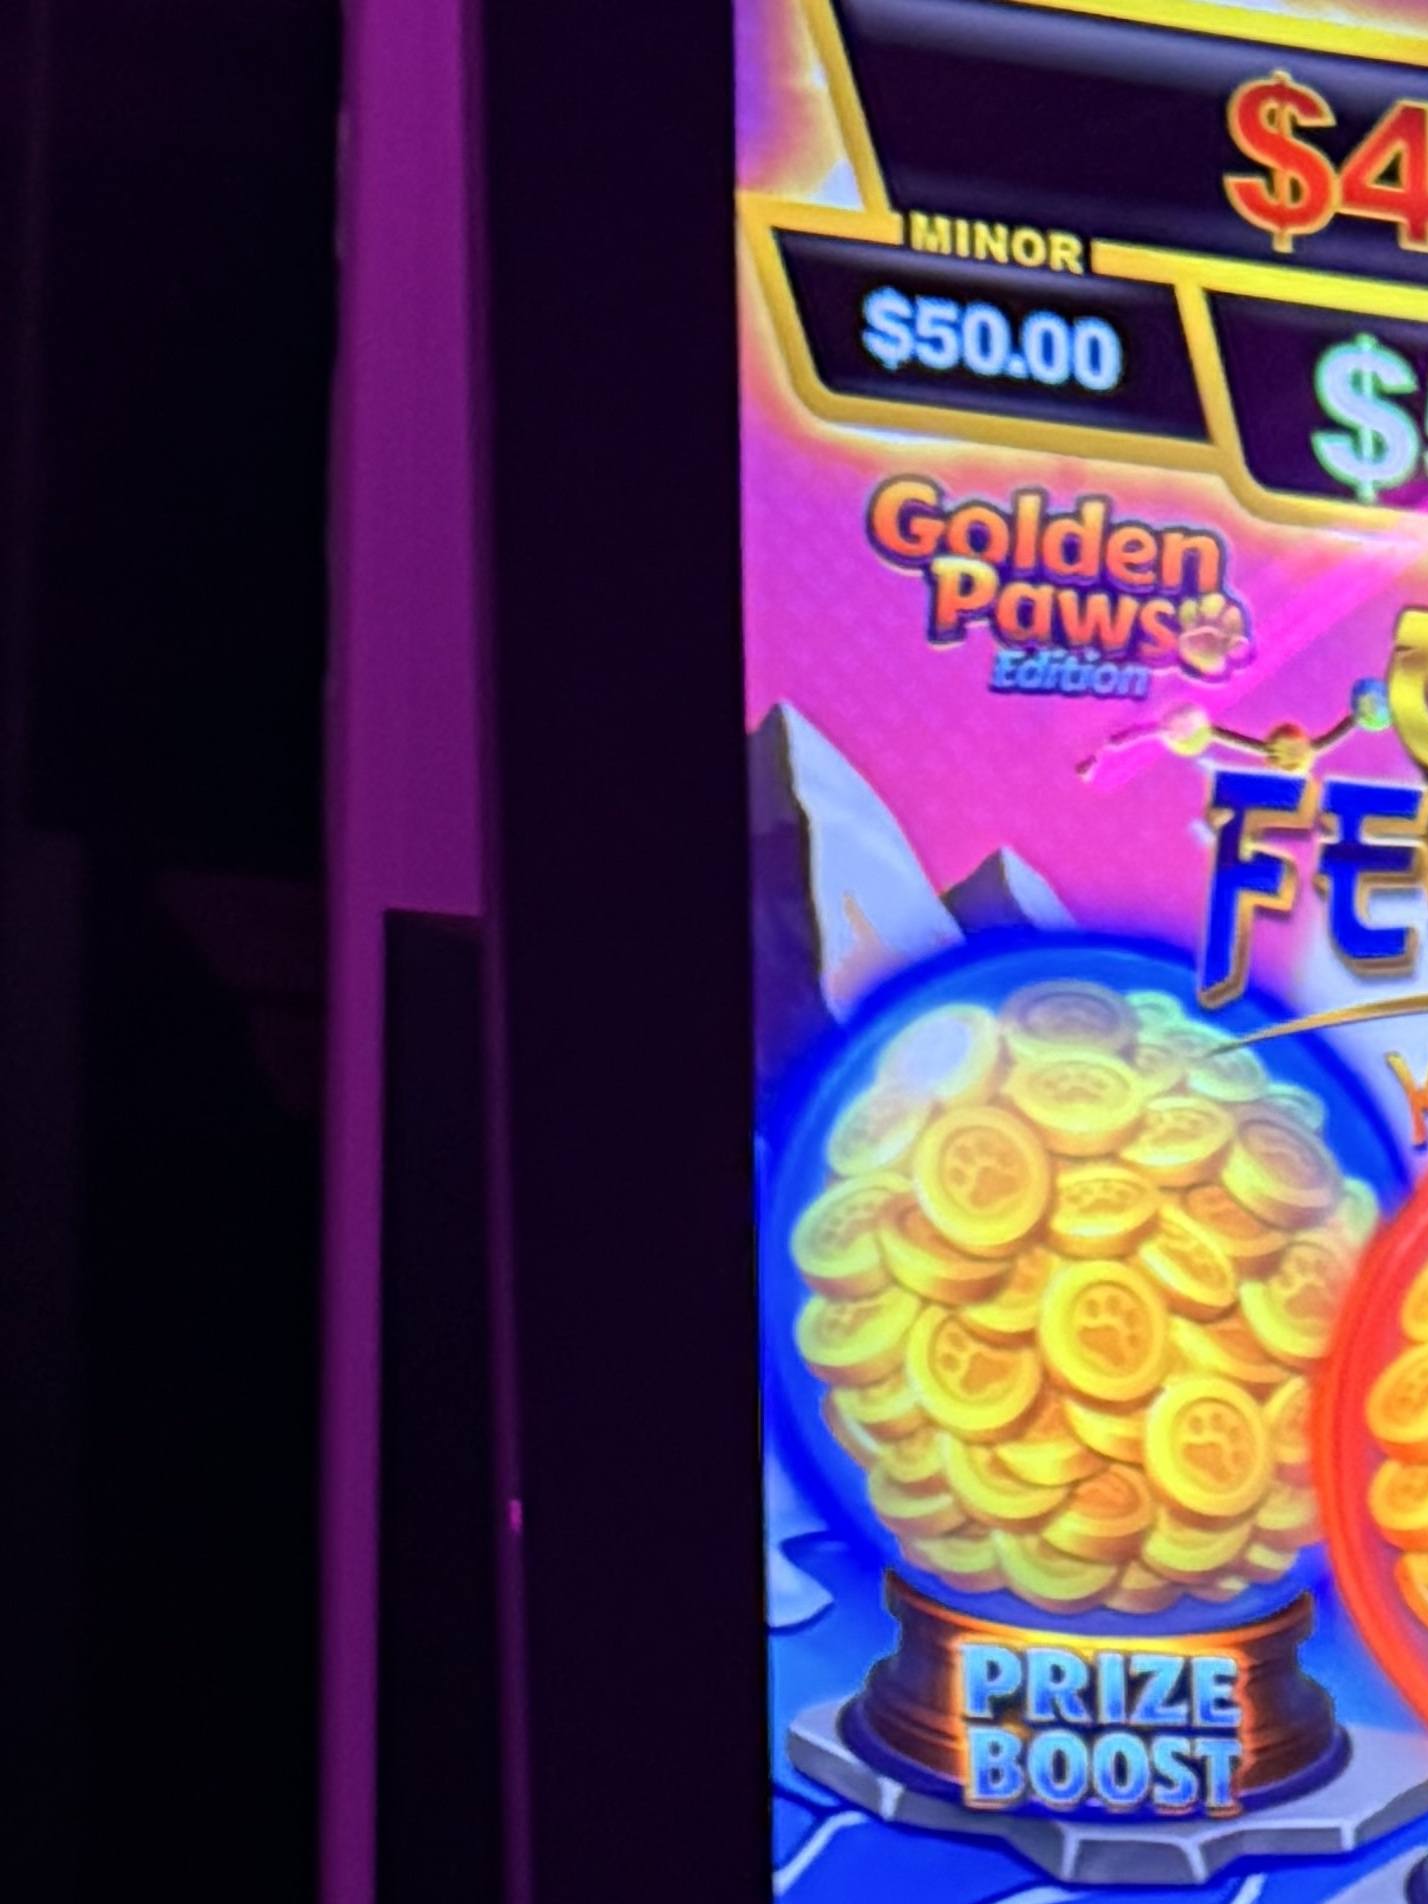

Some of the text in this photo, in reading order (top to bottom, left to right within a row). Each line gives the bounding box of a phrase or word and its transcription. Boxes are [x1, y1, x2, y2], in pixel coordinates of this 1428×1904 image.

[909, 214, 1084, 275] MINOR
[862, 287, 1123, 392] $50.00
[868, 476, 1224, 592] Golden
[928, 556, 1182, 660] Paws
[990, 648, 1152, 699] Edition
[958, 1641, 1243, 1730] PRIZE
[965, 1726, 1246, 1815] BOOST
